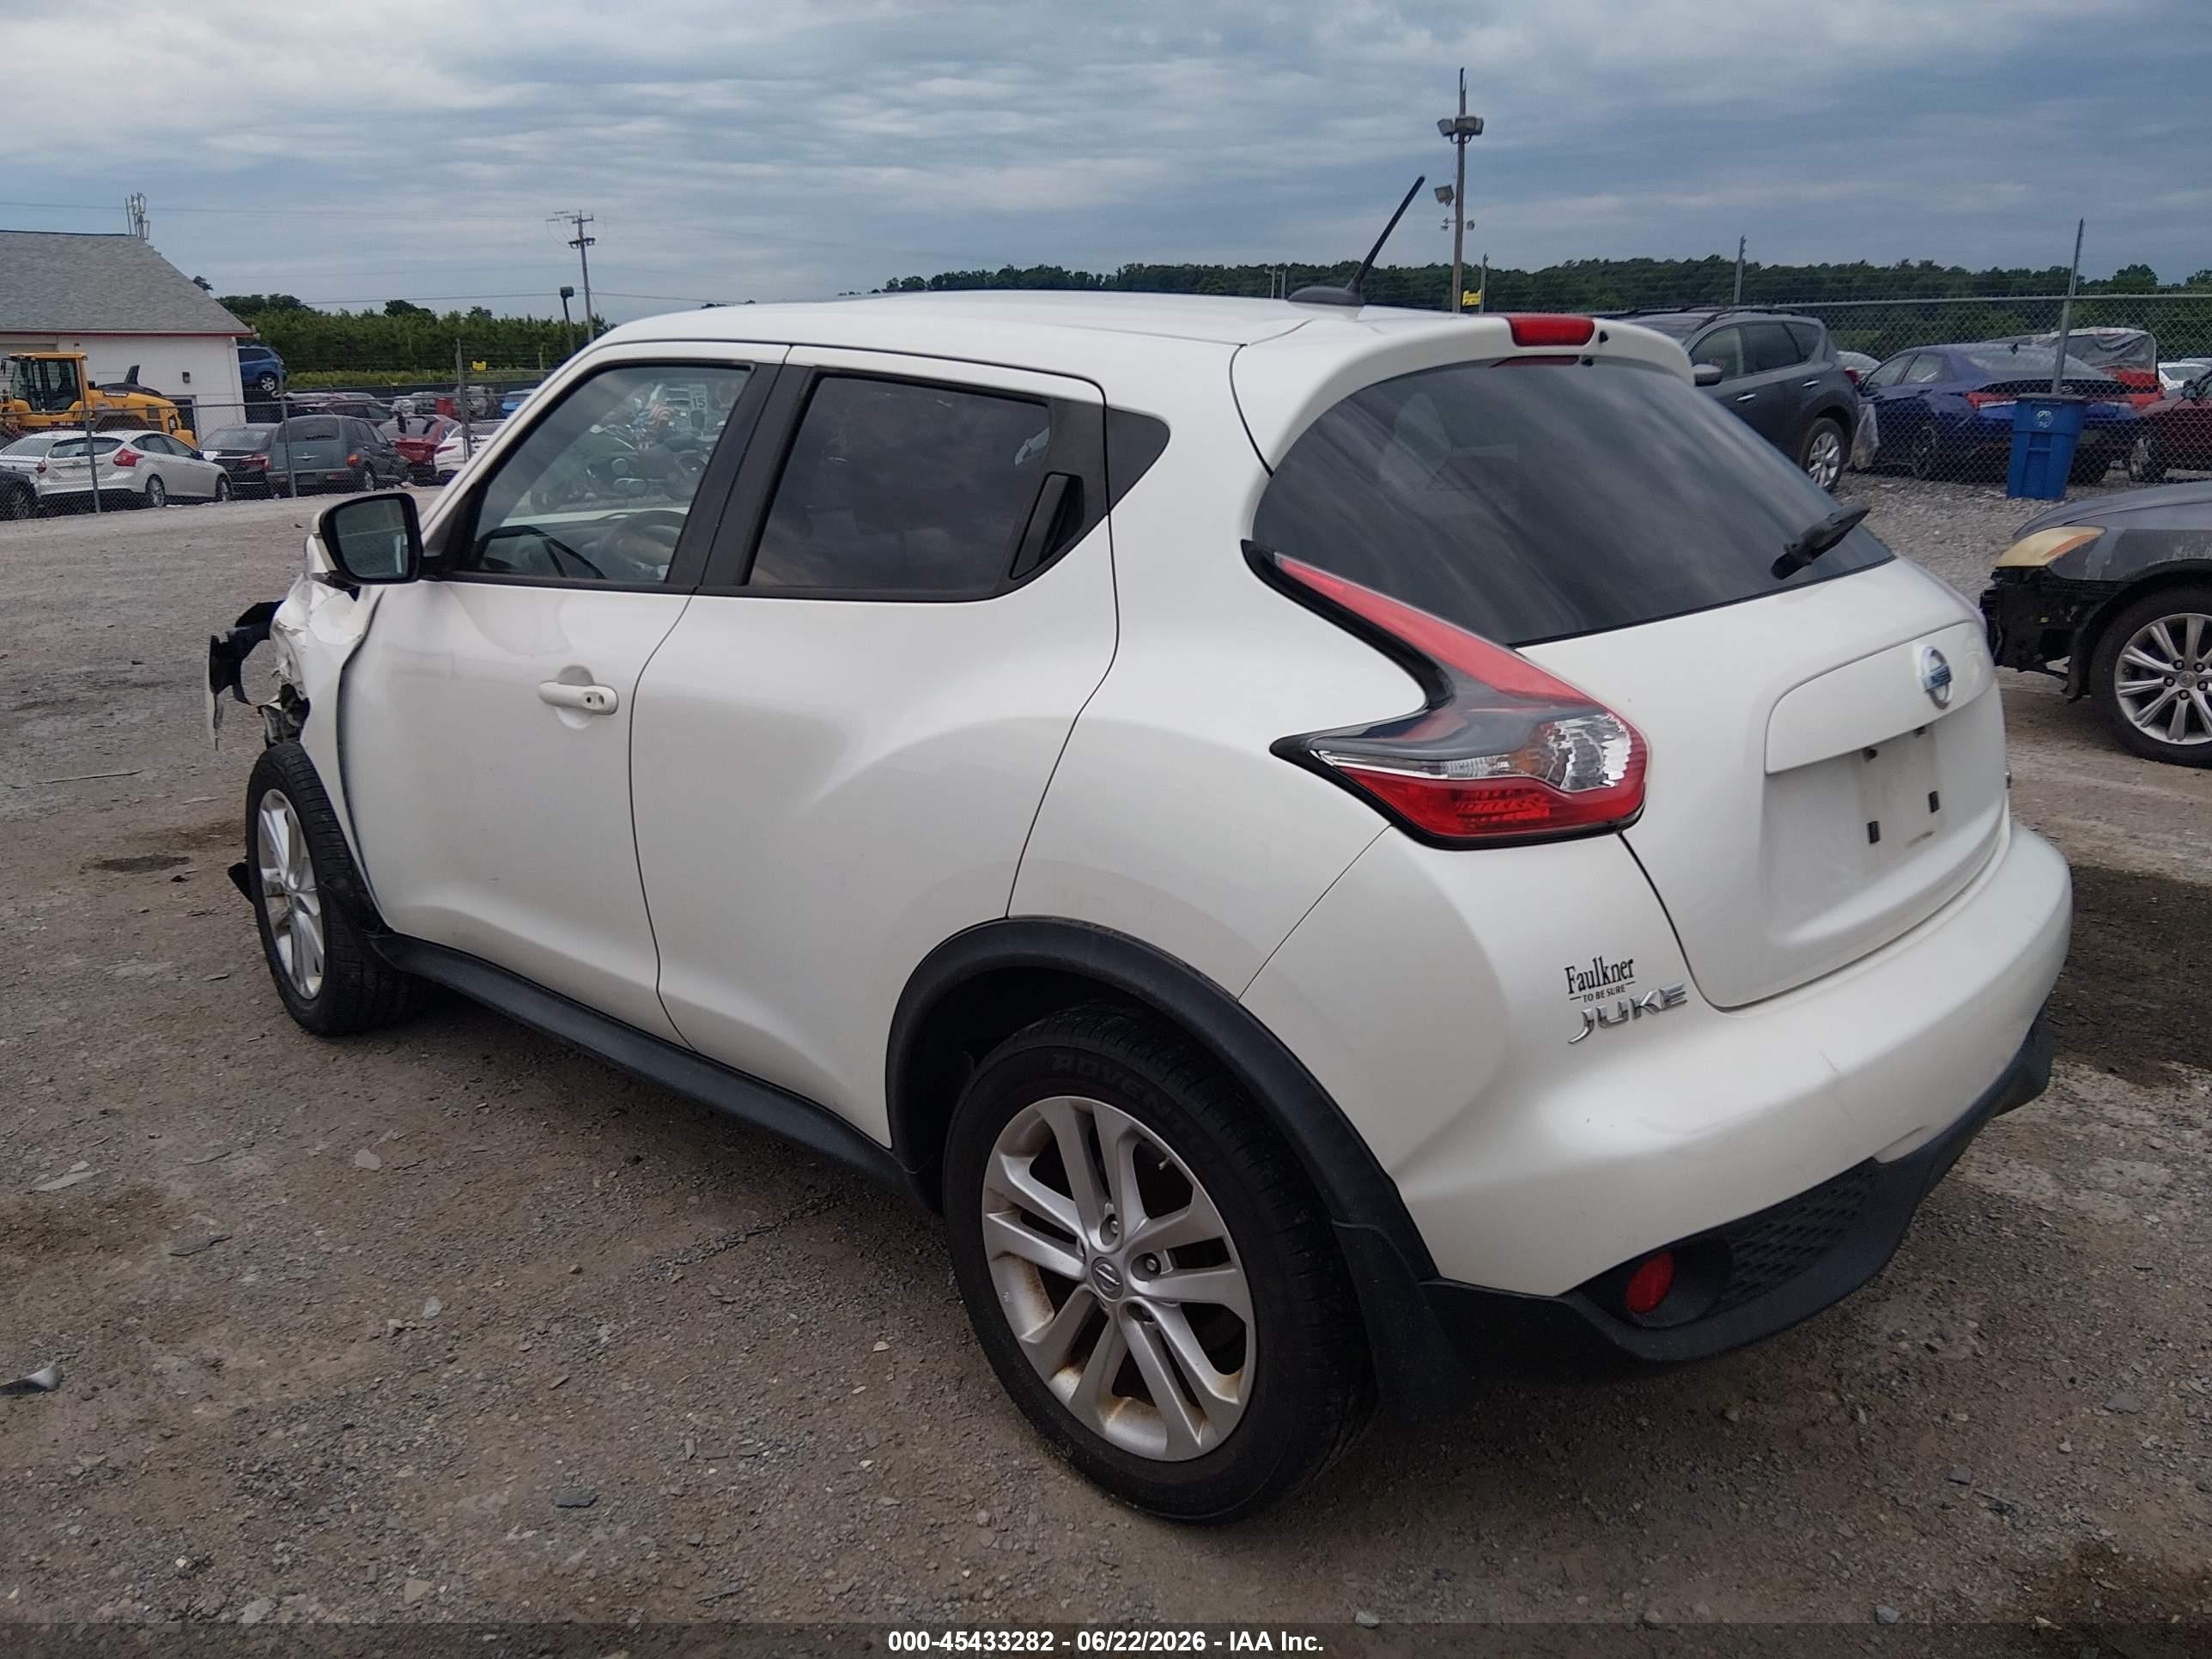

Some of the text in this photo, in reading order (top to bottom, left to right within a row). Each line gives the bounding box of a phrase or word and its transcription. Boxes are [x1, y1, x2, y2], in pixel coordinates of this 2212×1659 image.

[693, 398, 706, 409] 15
[1565, 955, 1635, 994] Faulkner
[1583, 984, 1626, 1003] TO BE SURE
[1567, 981, 1688, 1044] JUKE
